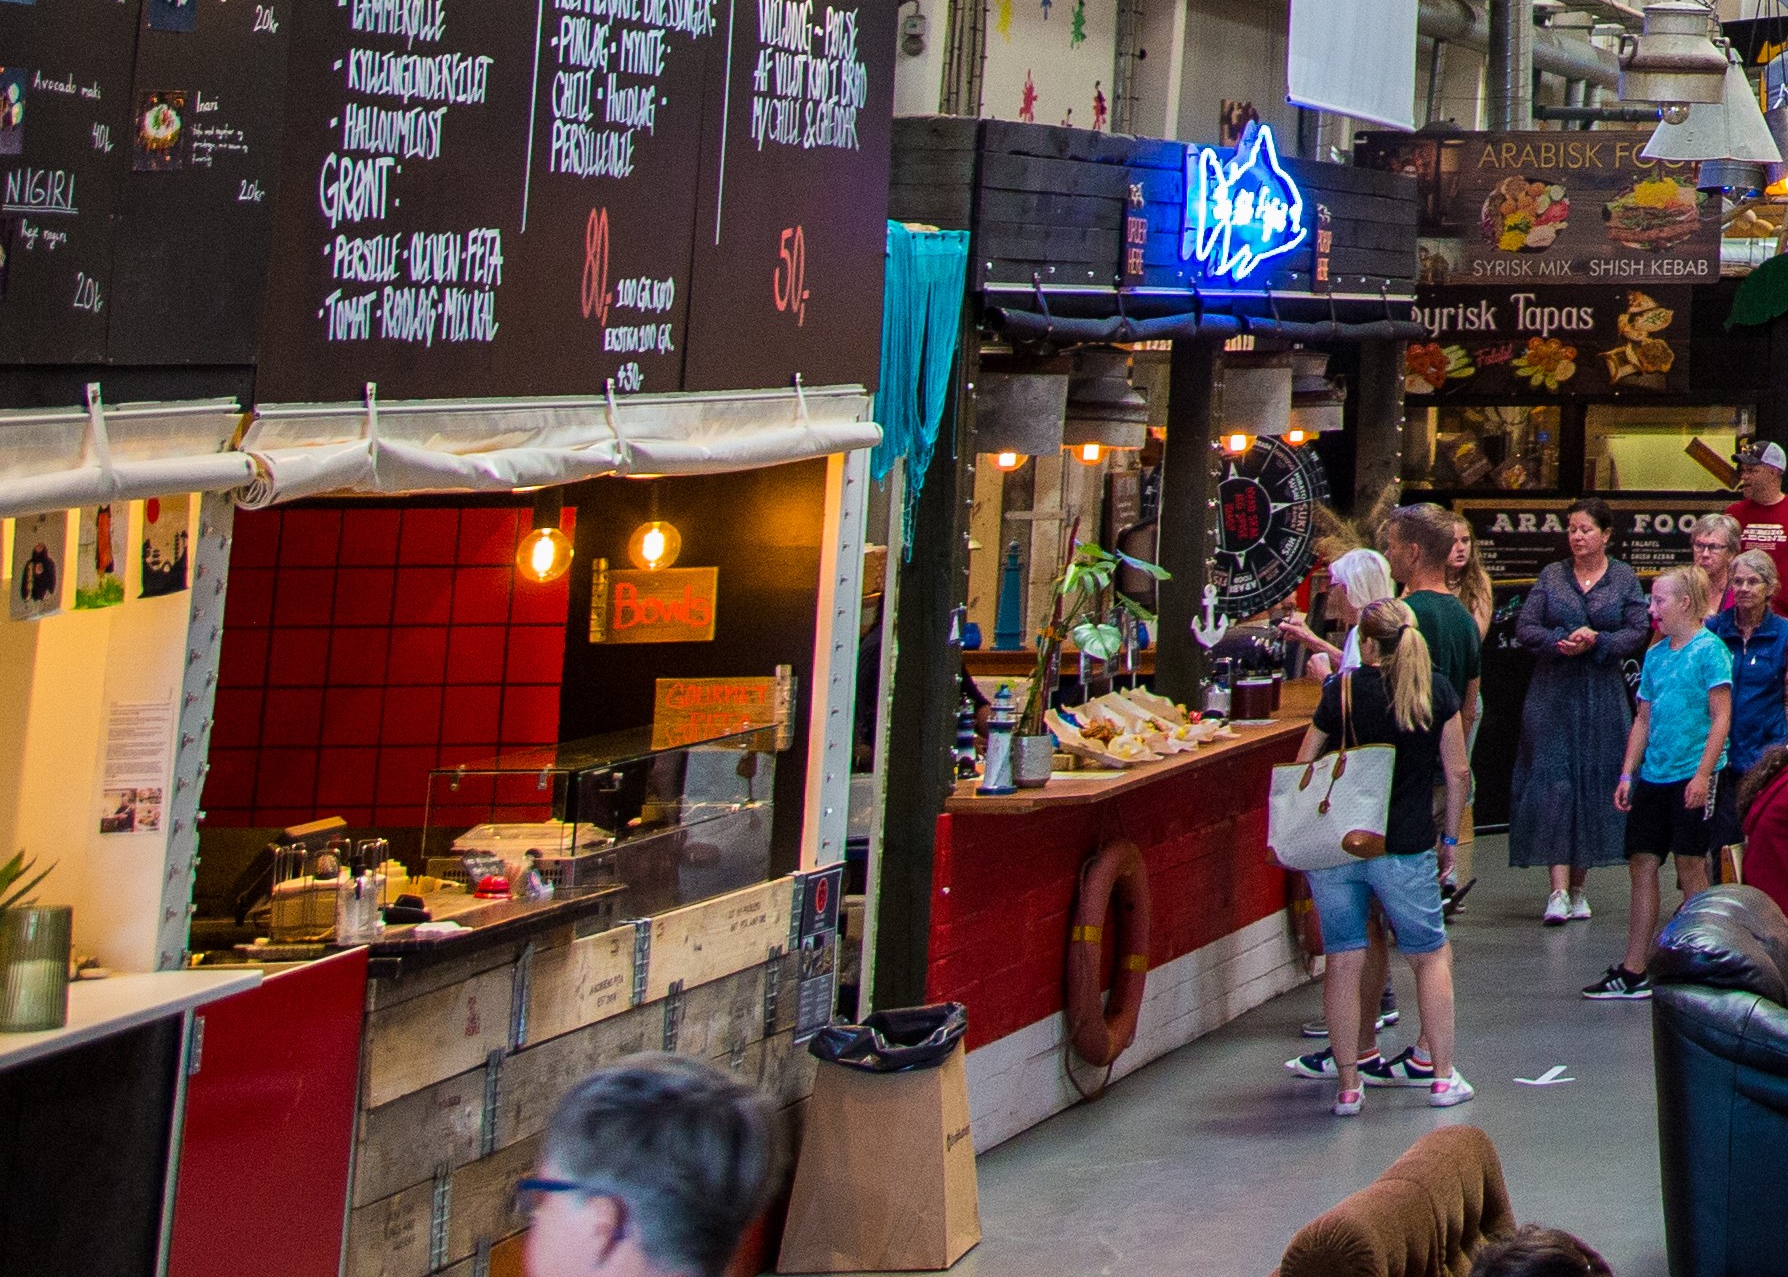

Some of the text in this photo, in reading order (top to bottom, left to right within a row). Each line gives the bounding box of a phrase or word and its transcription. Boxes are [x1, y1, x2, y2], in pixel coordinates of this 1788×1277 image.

[34, 69, 77, 94] Avocado
[1477, 142, 1603, 169] ARABISK
[6, 167, 75, 209] NIGIRI
[1472, 259, 1573, 278] SYRISK MIX
[1589, 259, 1709, 277] SHISH KEBAB
[1510, 293, 1594, 338] Tapas
[613, 582, 712, 630] Bowls
[665, 682, 769, 709] GOURMET
